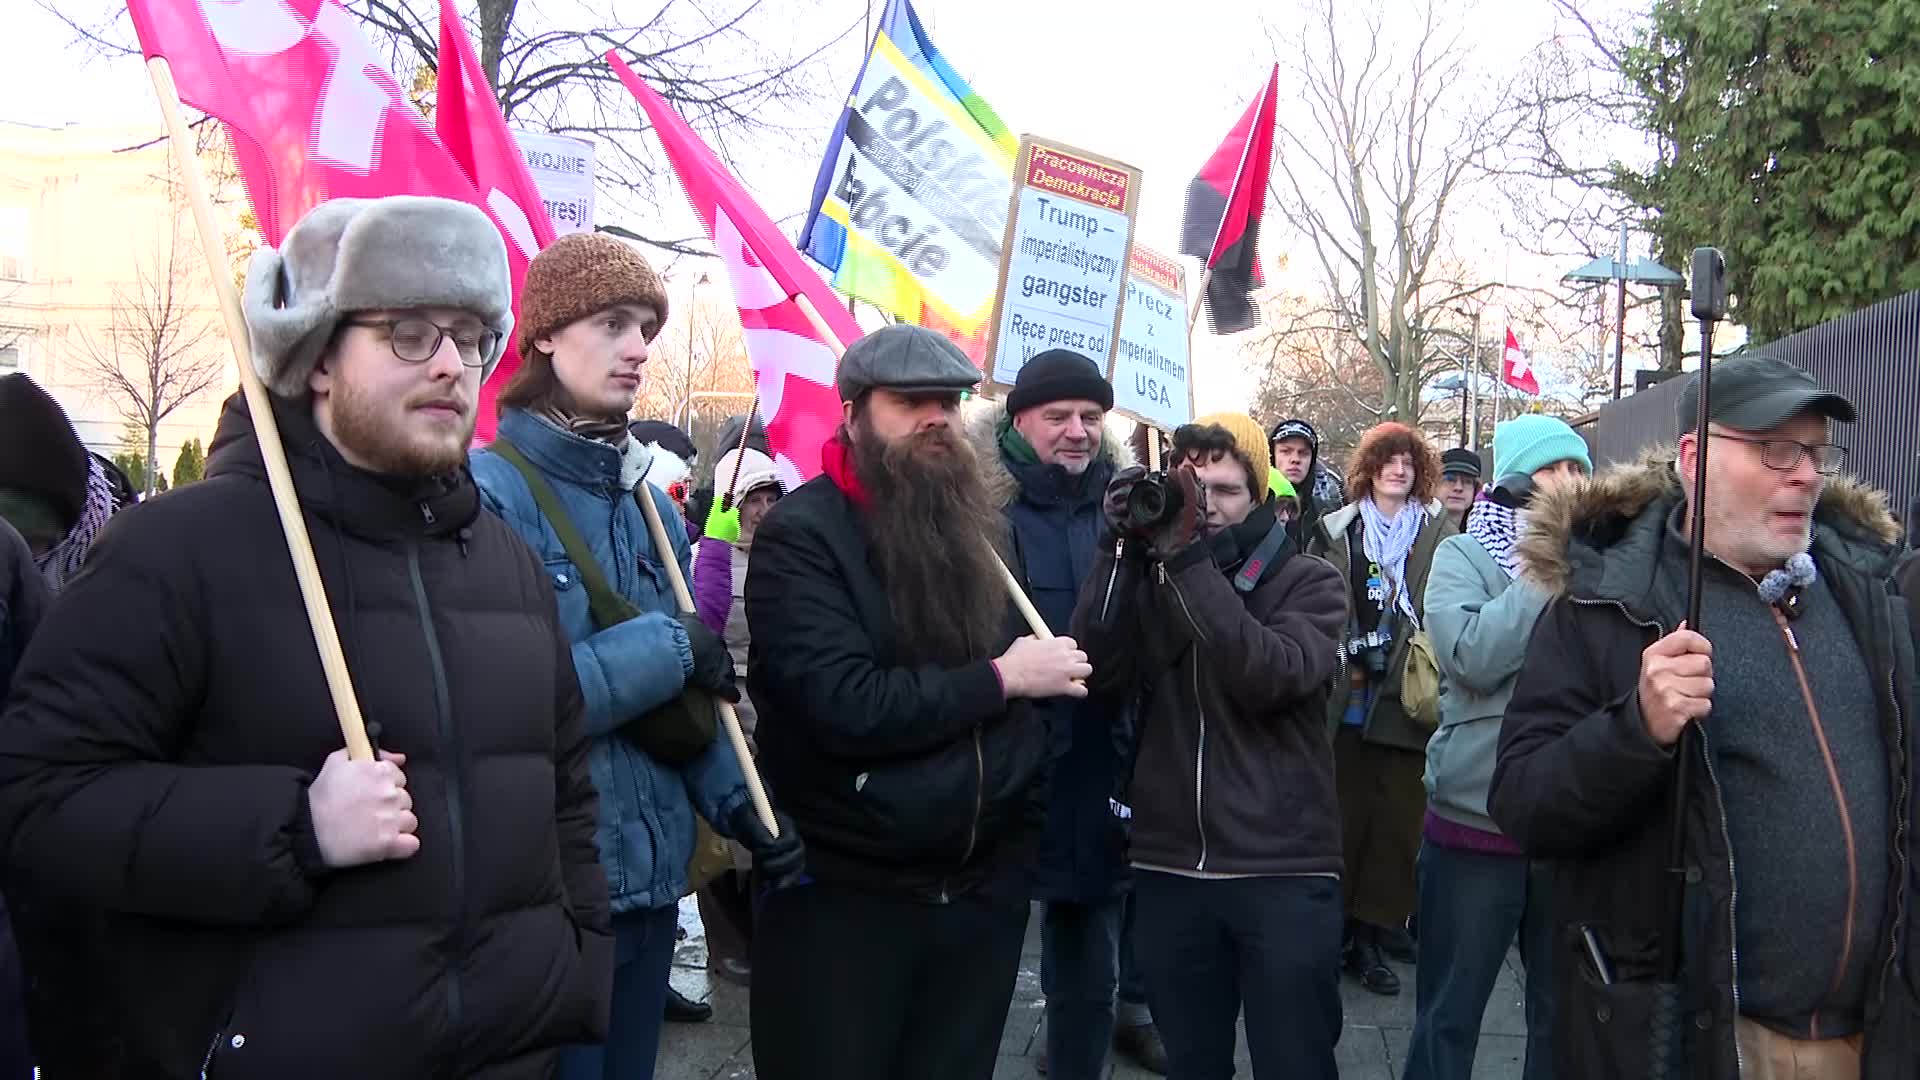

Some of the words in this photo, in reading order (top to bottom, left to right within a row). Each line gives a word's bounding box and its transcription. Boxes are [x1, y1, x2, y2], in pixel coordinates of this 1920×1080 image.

[528, 151, 586, 175] WOJNIE
[861, 76, 1006, 234] Polskie
[1033, 147, 1126, 188] Pracownicza
[1032, 169, 1121, 208] Demokracja
[1037, 198, 1098, 238] Trump
[1021, 228, 1118, 282] imperialistyczny
[1022, 275, 1107, 309] gangster
[1127, 282, 1172, 320] Precz
[1011, 314, 1046, 342] Ręce
[1048, 327, 1085, 348] precz
[1088, 334, 1104, 352] od
[1147, 323, 1154, 336] z
[1120, 337, 1185, 382] mperializmem
[1136, 372, 1171, 409] USA
